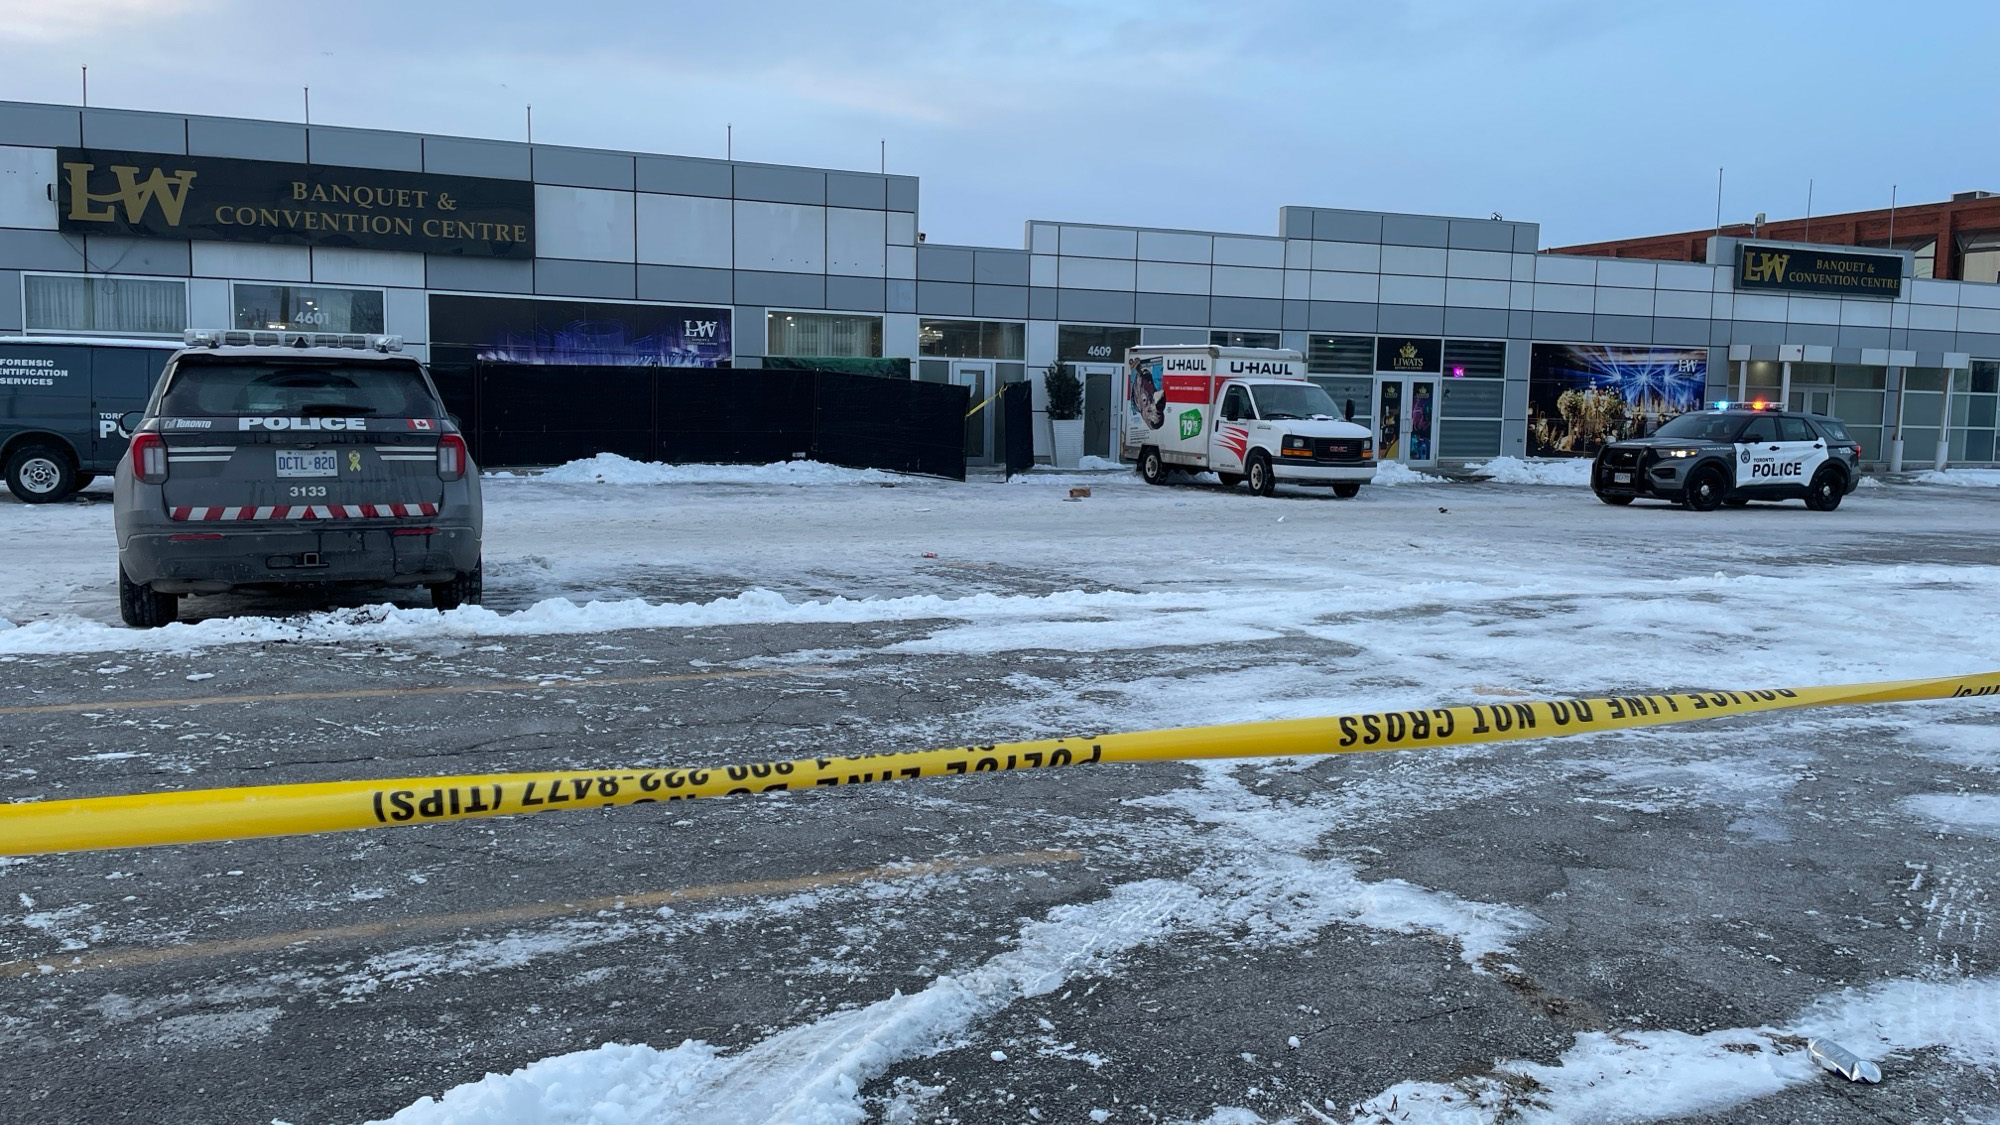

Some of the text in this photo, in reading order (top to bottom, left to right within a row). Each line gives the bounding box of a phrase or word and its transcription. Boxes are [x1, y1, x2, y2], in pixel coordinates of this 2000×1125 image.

[291, 181, 457, 211] BANQUET &
[215, 205, 528, 242] CONVENTION CENTRE
[1816, 259, 1875, 273] BANQUET &
[1788, 271, 1899, 289] CONVENTION CENTRE
[294, 311, 329, 325] 4601
[1087, 345, 1112, 357] 4609
[0, 358, 54, 367] FORENSIC
[1167, 359, 1207, 371] U-HAUL
[1230, 361, 1293, 375] U-HAUL
[1393, 357, 1424, 367] LIWATS
[0, 378, 54, 386] SERVICES
[238, 417, 367, 431] POLICE
[278, 456, 336, 470] DCTL 820
[1752, 462, 1802, 477] POLICE
[289, 486, 327, 497] 3133
[1471, 703, 1536, 734] NOT
[1547, 699, 1594, 726] DO
[1339, 709, 1455, 747] CROSS
[373, 784, 503, 823] (TIPS)
